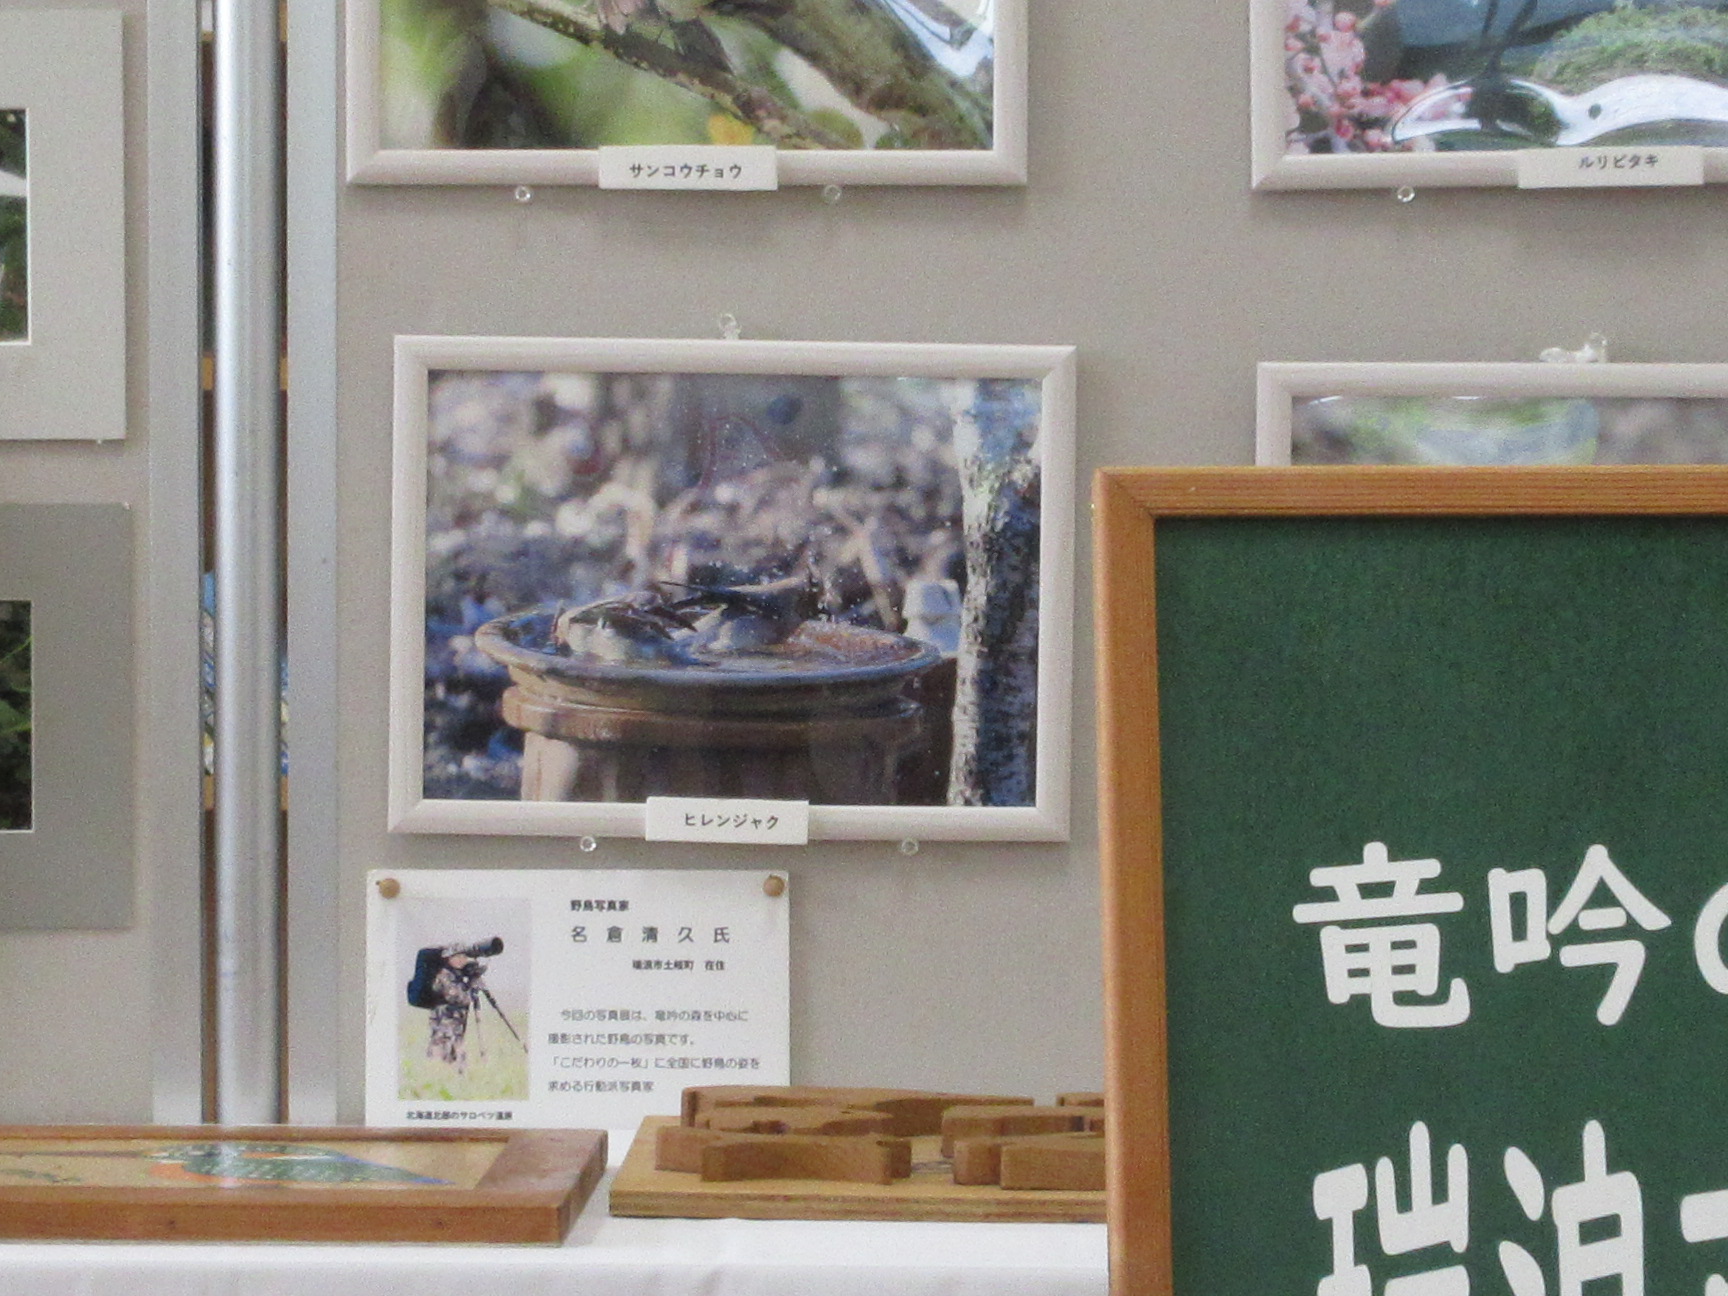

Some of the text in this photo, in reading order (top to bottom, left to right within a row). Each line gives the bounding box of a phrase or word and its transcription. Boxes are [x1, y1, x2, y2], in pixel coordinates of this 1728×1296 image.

[628, 162, 742, 179] サンコウチョウ
[684, 813, 780, 830] ヒレンジャク
[570, 899, 630, 912] 野鳥写真家
